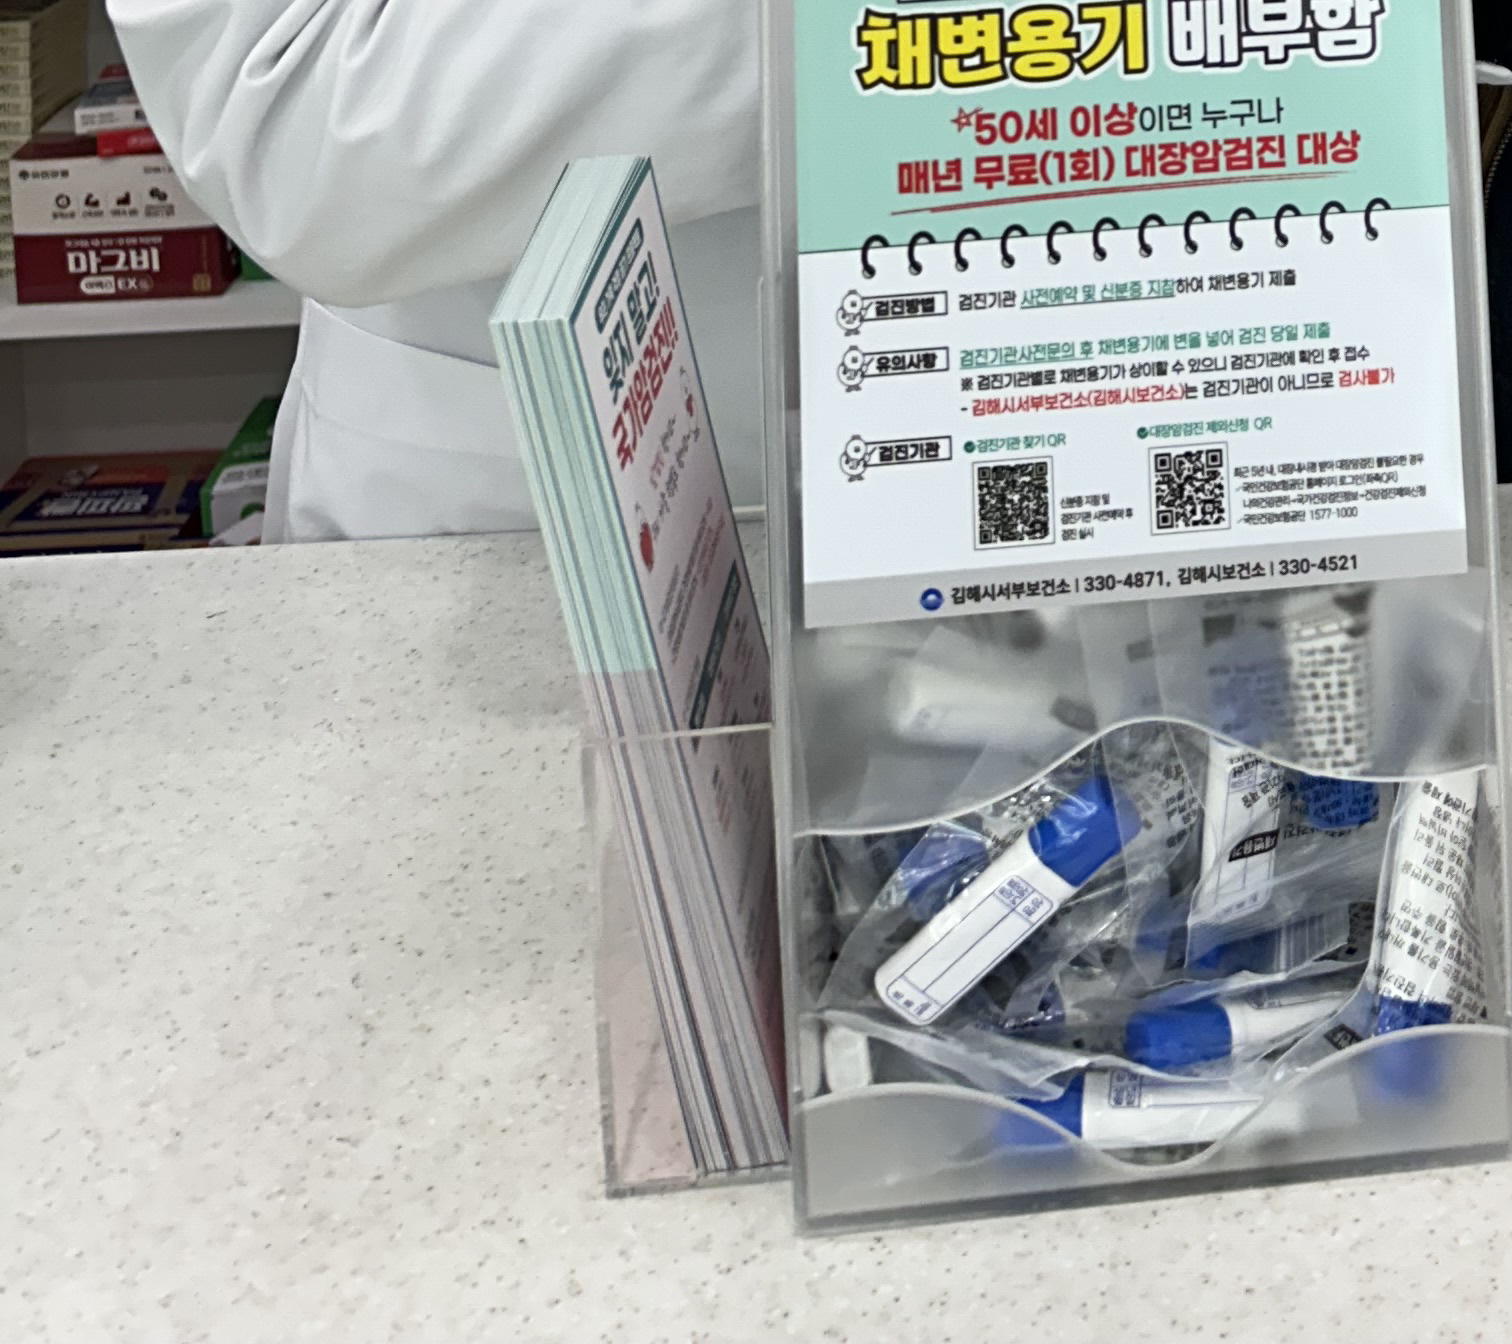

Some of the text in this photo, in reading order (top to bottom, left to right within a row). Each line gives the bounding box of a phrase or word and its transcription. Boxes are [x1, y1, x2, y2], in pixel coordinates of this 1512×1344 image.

[974, 97, 1284, 145] 50세 이상이면 누구나
[897, 130, 1361, 195] 매년 무료(1회) 대장암검진 대상
[958, 290, 1016, 311] 검진기관
[1020, 284, 1078, 307] 사전예약
[1081, 283, 1096, 302] 및
[1147, 275, 1203, 298] 지참하여
[1207, 270, 1264, 292] 채변용기
[1268, 268, 1296, 288] 제출
[875, 295, 936, 317] 검진방법
[1079, 340, 1094, 358] 후
[1173, 331, 1202, 351] 변을
[1238, 326, 1266, 346] 검진
[1270, 323, 1298, 342] 당일
[1302, 321, 1331, 340] 제출
[876, 352, 937, 373] 유의사항
[1171, 360, 1185, 376] 수
[1187, 355, 1227, 375] 있으니
[1230, 349, 1296, 372] 검진기관에
[1328, 346, 1342, 363] 후
[1344, 344, 1371, 362] 접수
[1277, 370, 1335, 392] 아니므로
[1338, 367, 1395, 388] 검사불가
[878, 442, 940, 462] 검진기관
[1047, 433, 1066, 448] QR
[951, 579, 1072, 605] 김해시서부보건소
[1177, 564, 1267, 586] 김해시보건소
[1279, 555, 1359, 577] 330-4521
